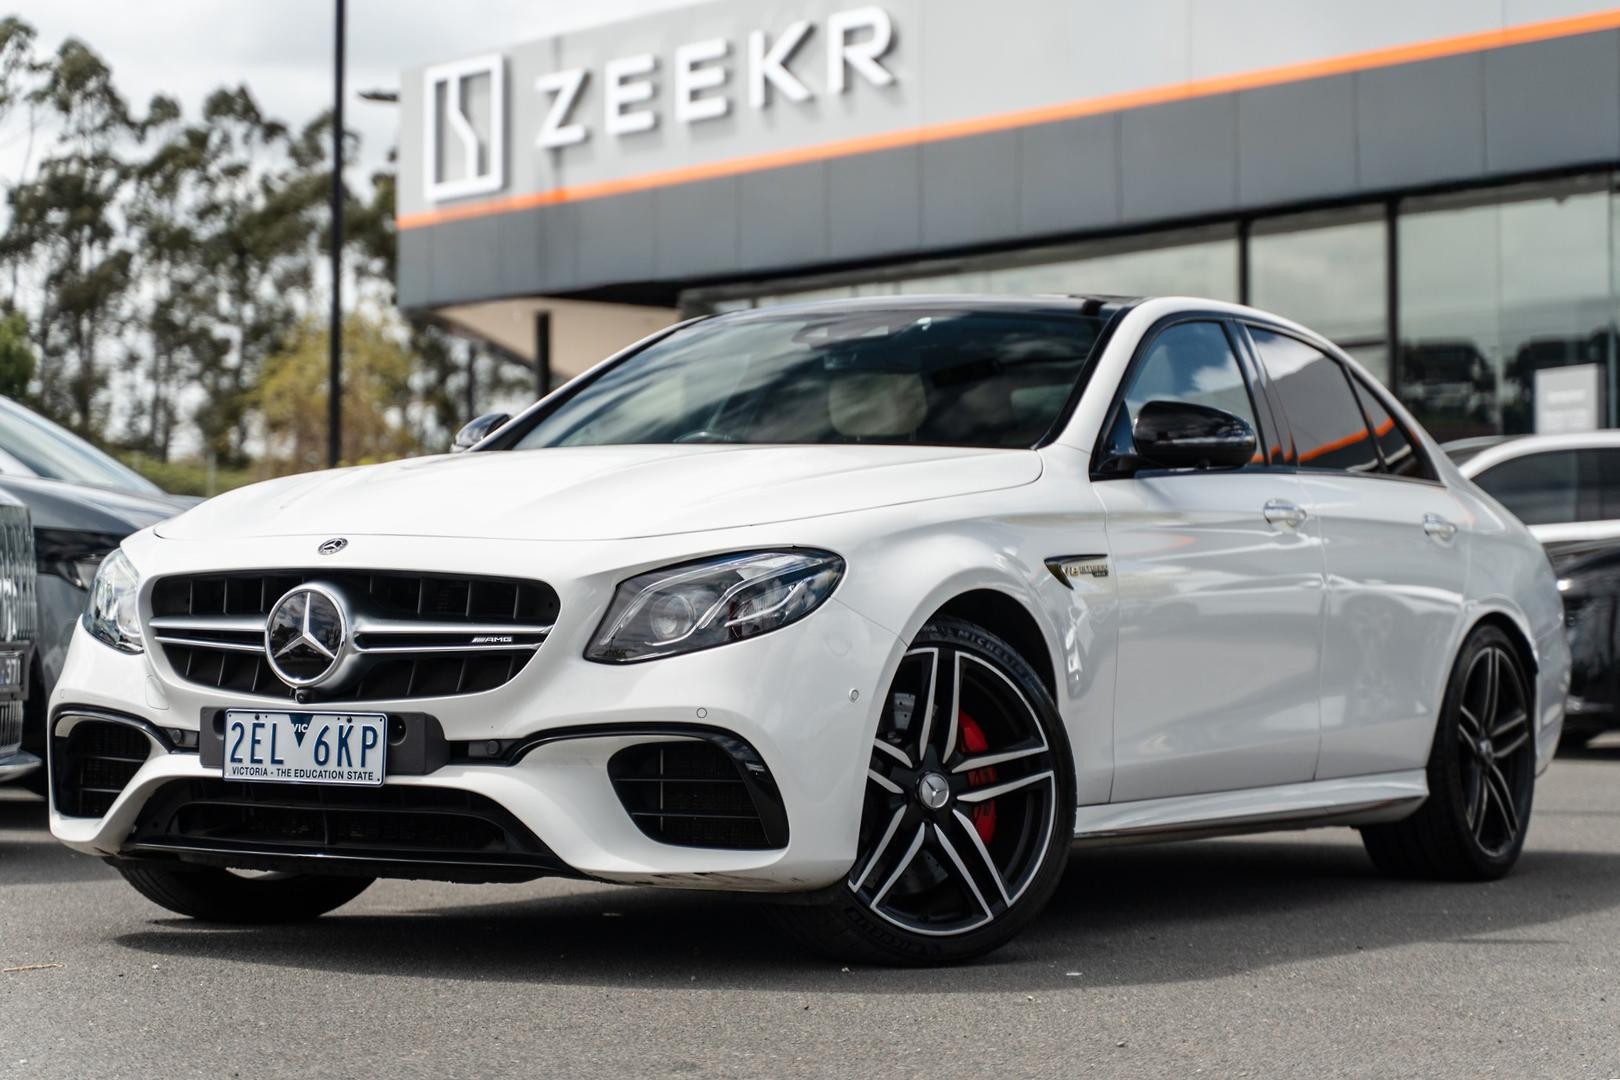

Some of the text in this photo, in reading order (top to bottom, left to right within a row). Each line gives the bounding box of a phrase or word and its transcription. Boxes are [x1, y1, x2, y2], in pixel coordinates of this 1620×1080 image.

[533, 5, 894, 148] ZEEKR
[290, 723, 308, 733] VIC
[230, 721, 378, 768] 2EL 6KP
[232, 766, 268, 777] VICTORIA
[276, 768, 292, 778] THE
[294, 769, 344, 780] EDUCATION
[347, 771, 374, 781] STATE
